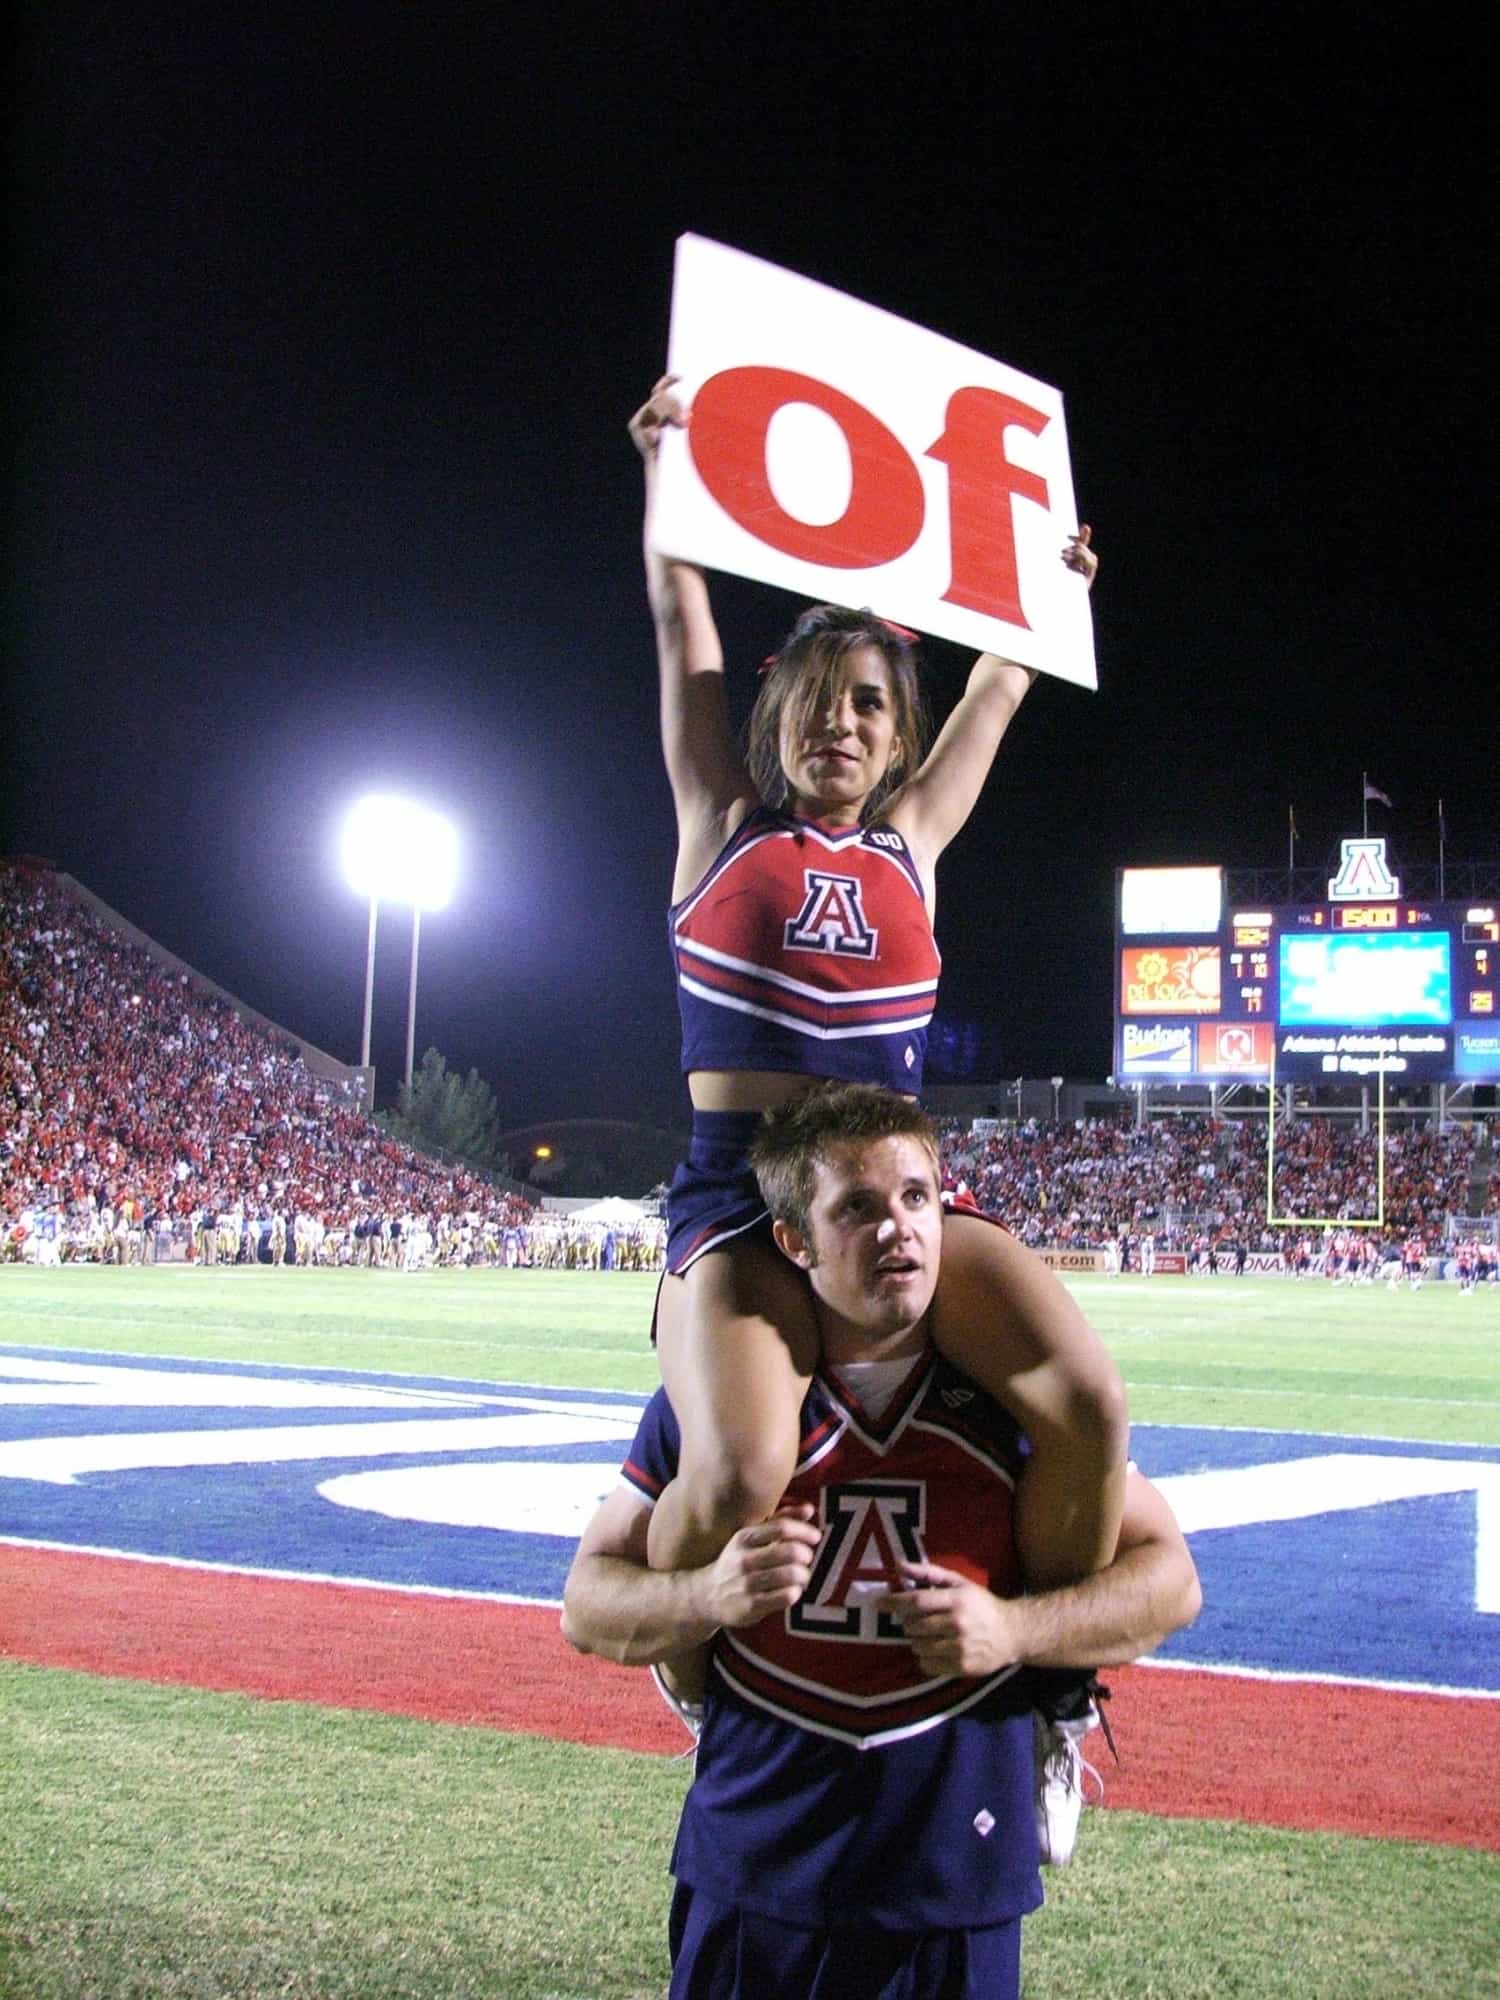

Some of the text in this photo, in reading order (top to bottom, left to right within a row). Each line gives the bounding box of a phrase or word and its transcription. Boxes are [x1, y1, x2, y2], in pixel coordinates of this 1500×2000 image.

[783, 868, 879, 960] A
[1124, 1024, 1191, 1045] Budget
[784, 1478, 930, 1644] A
